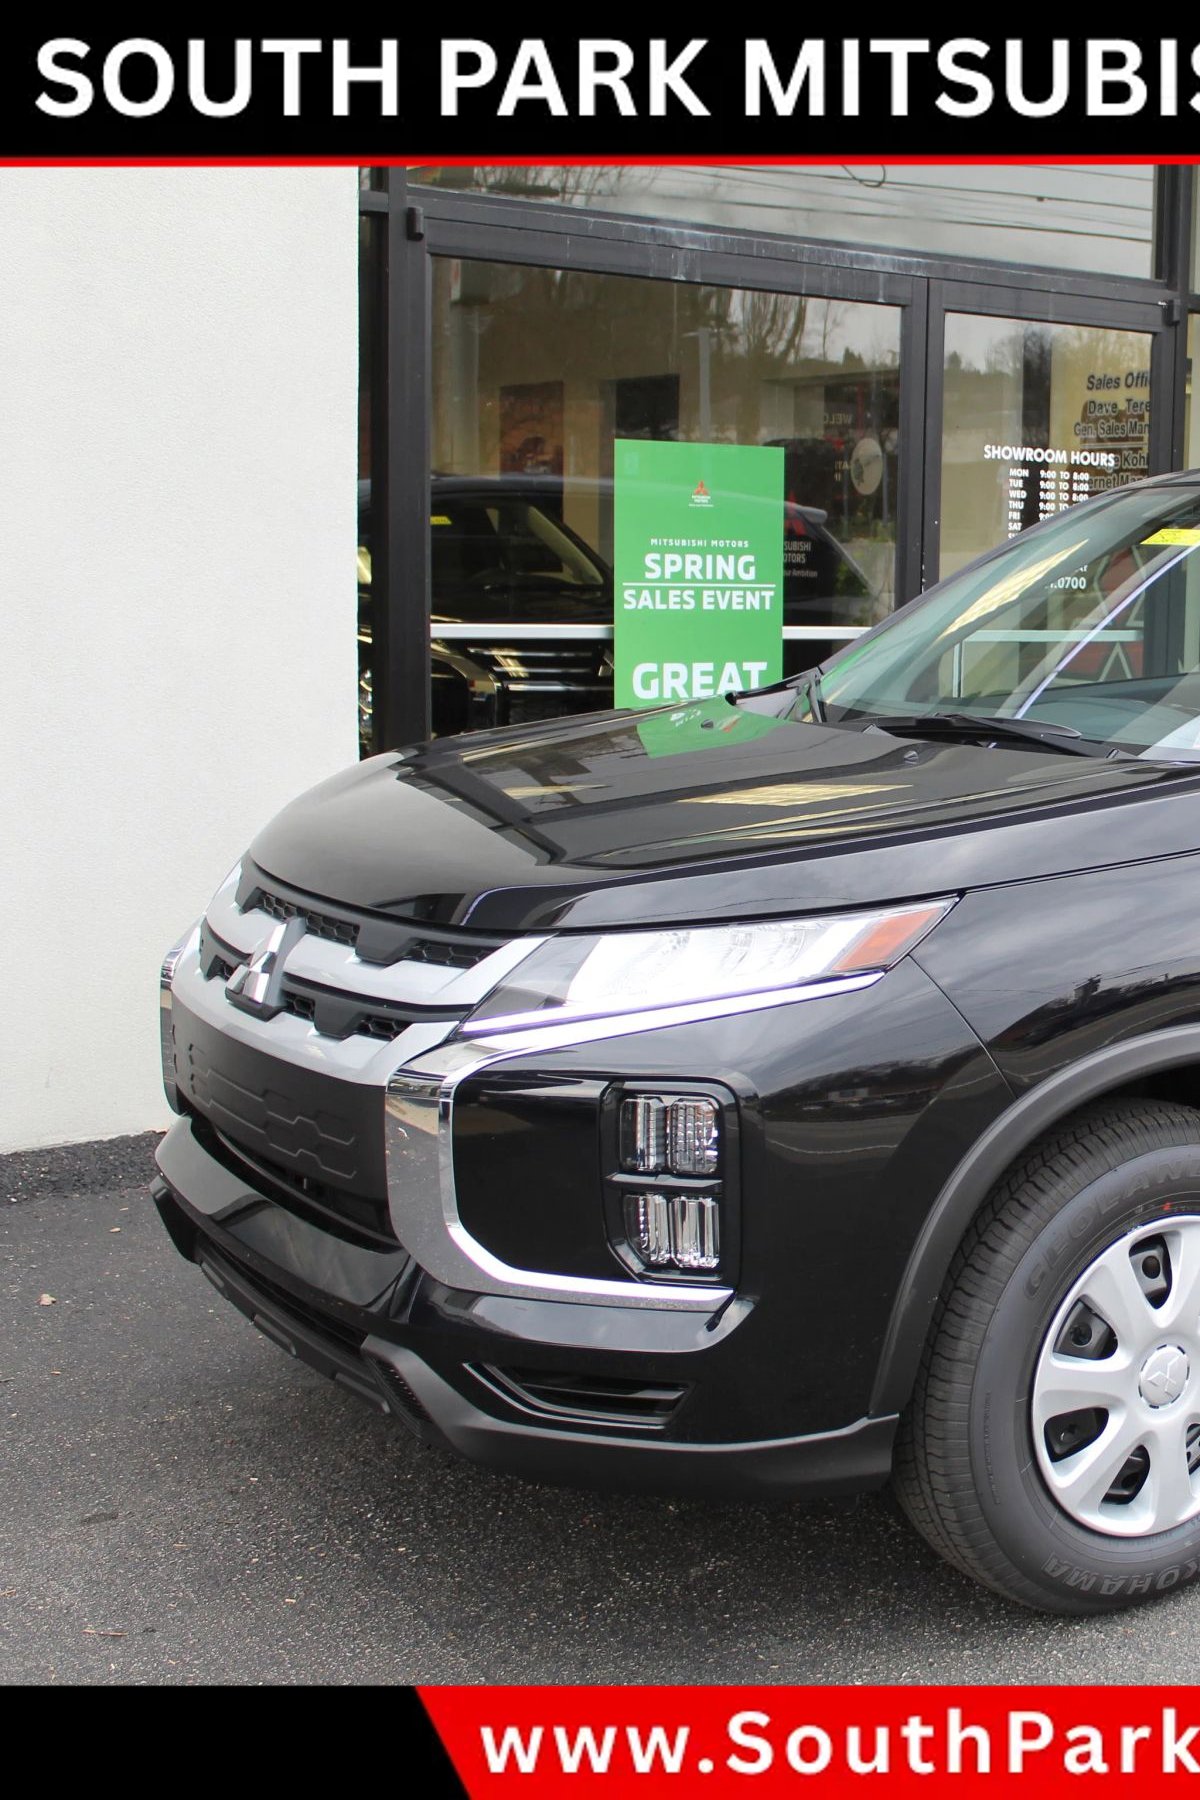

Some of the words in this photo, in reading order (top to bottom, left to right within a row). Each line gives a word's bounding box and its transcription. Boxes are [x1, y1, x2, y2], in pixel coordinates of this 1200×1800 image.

[1087, 374, 1120, 391] Sales
[1124, 371, 1150, 388] Offi
[1088, 400, 1118, 415] Dave
[1126, 398, 1151, 413] Tere
[1074, 422, 1096, 436] Gen.
[1099, 421, 1126, 436] Sales
[1128, 421, 1151, 435] Man
[983, 444, 1067, 465] SHOWROOM
[1071, 450, 1115, 468] HOURS
[1009, 468, 1029, 477] MON
[1040, 470, 1056, 480] 9:00
[1060, 471, 1070, 480] TO
[1073, 471, 1090, 481] 8:00
[1009, 479, 1023, 488] TUE
[1040, 480, 1056, 490] 9:00
[1059, 481, 1069, 490] TO
[1073, 483, 1089, 492] 8:00
[1009, 490, 1027, 499] WED
[1039, 491, 1056, 500] 9:00
[1059, 492, 1069, 501] TO
[1072, 493, 1089, 501] 8:00
[1009, 501, 1024, 510] THU
[1039, 502, 1056, 511] 9:00
[1008, 512, 1020, 521] FRI
[1008, 523, 1022, 531] SAT
[650, 538, 707, 547] MITSUBISHI
[710, 539, 749, 548] MOTORS
[783, 540, 812, 552] SUBISHI
[644, 552, 756, 581] SPRING
[623, 588, 695, 611] SALES
[702, 589, 775, 611] EVENT
[632, 661, 768, 700] GREAT
